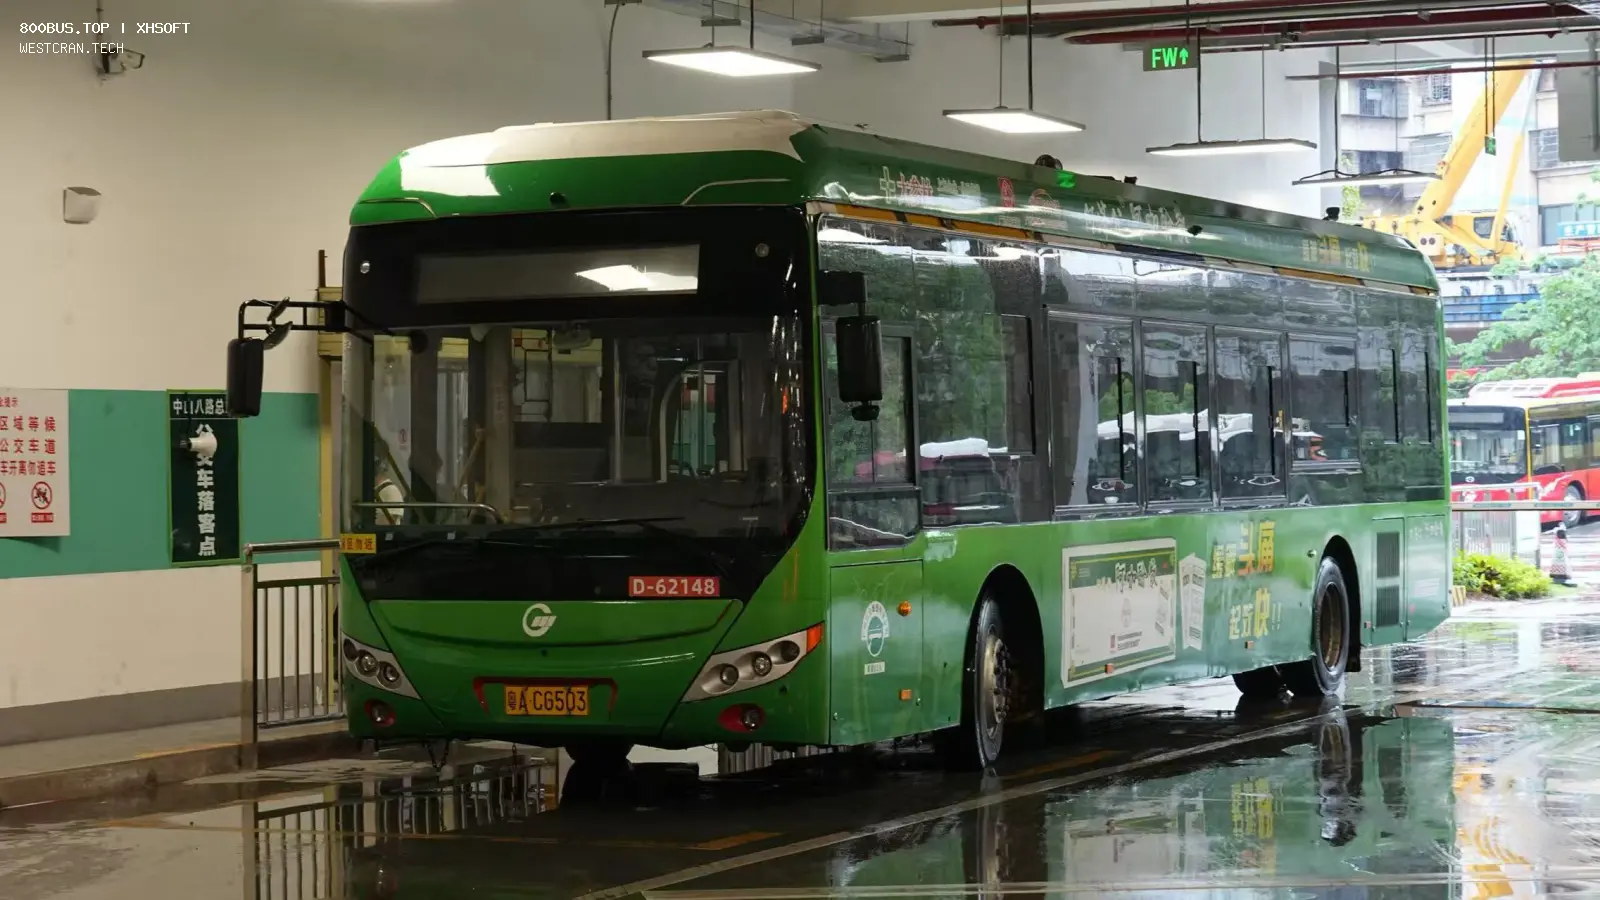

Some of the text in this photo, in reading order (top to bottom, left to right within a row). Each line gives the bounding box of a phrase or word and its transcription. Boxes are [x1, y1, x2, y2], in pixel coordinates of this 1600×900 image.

[1151, 47, 1178, 68] FW
[172, 398, 228, 416] 中山八路总
[0, 439, 56, 455] 公交车道
[632, 578, 715, 595] D-62148
